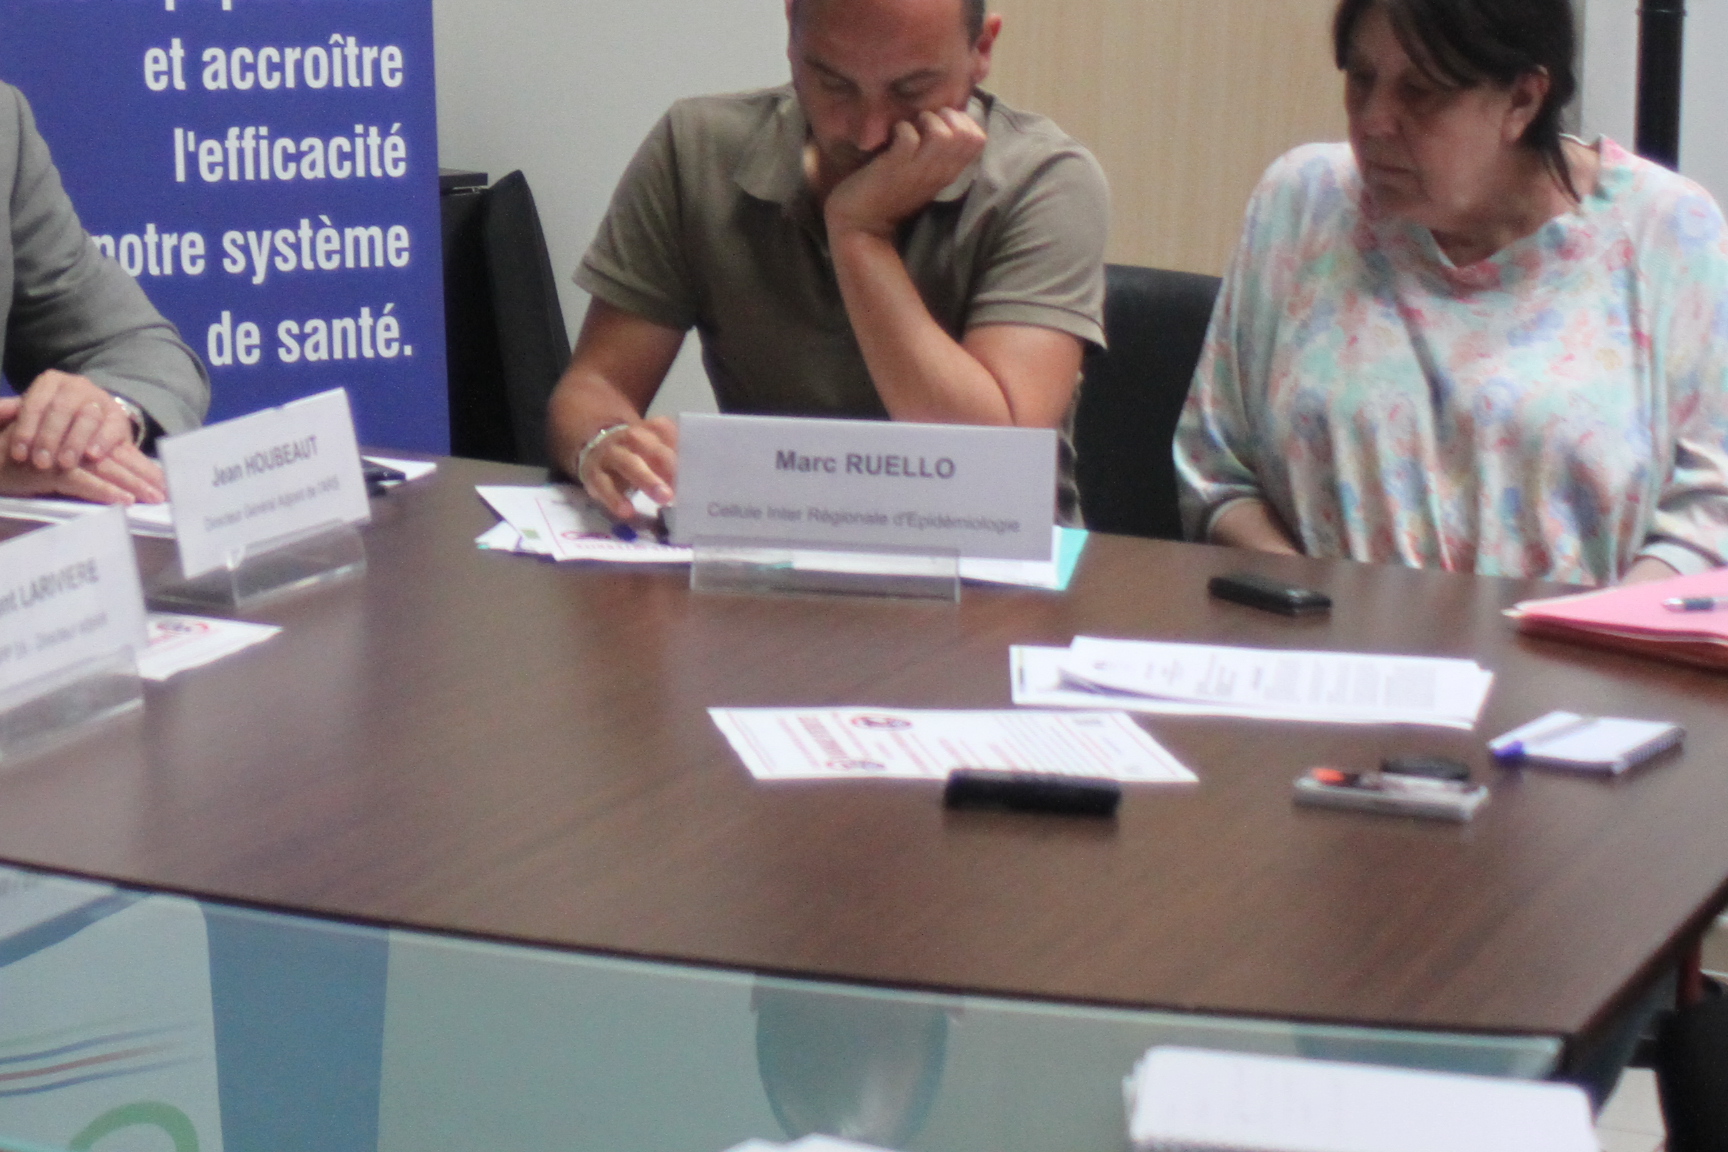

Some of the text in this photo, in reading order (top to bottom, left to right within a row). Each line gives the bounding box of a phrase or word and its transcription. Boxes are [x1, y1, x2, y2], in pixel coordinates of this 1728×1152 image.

[144, 34, 404, 91] et accroître
[174, 123, 407, 182] l'efficacité
[222, 215, 410, 285] système
[207, 303, 413, 366] de santé.
[212, 434, 318, 487] Jean HOUBEAUT
[775, 450, 956, 479] Marc RUELLO
[707, 501, 762, 520] Cellule
[767, 505, 802, 521] Inter
[807, 506, 889, 527] Régionale
